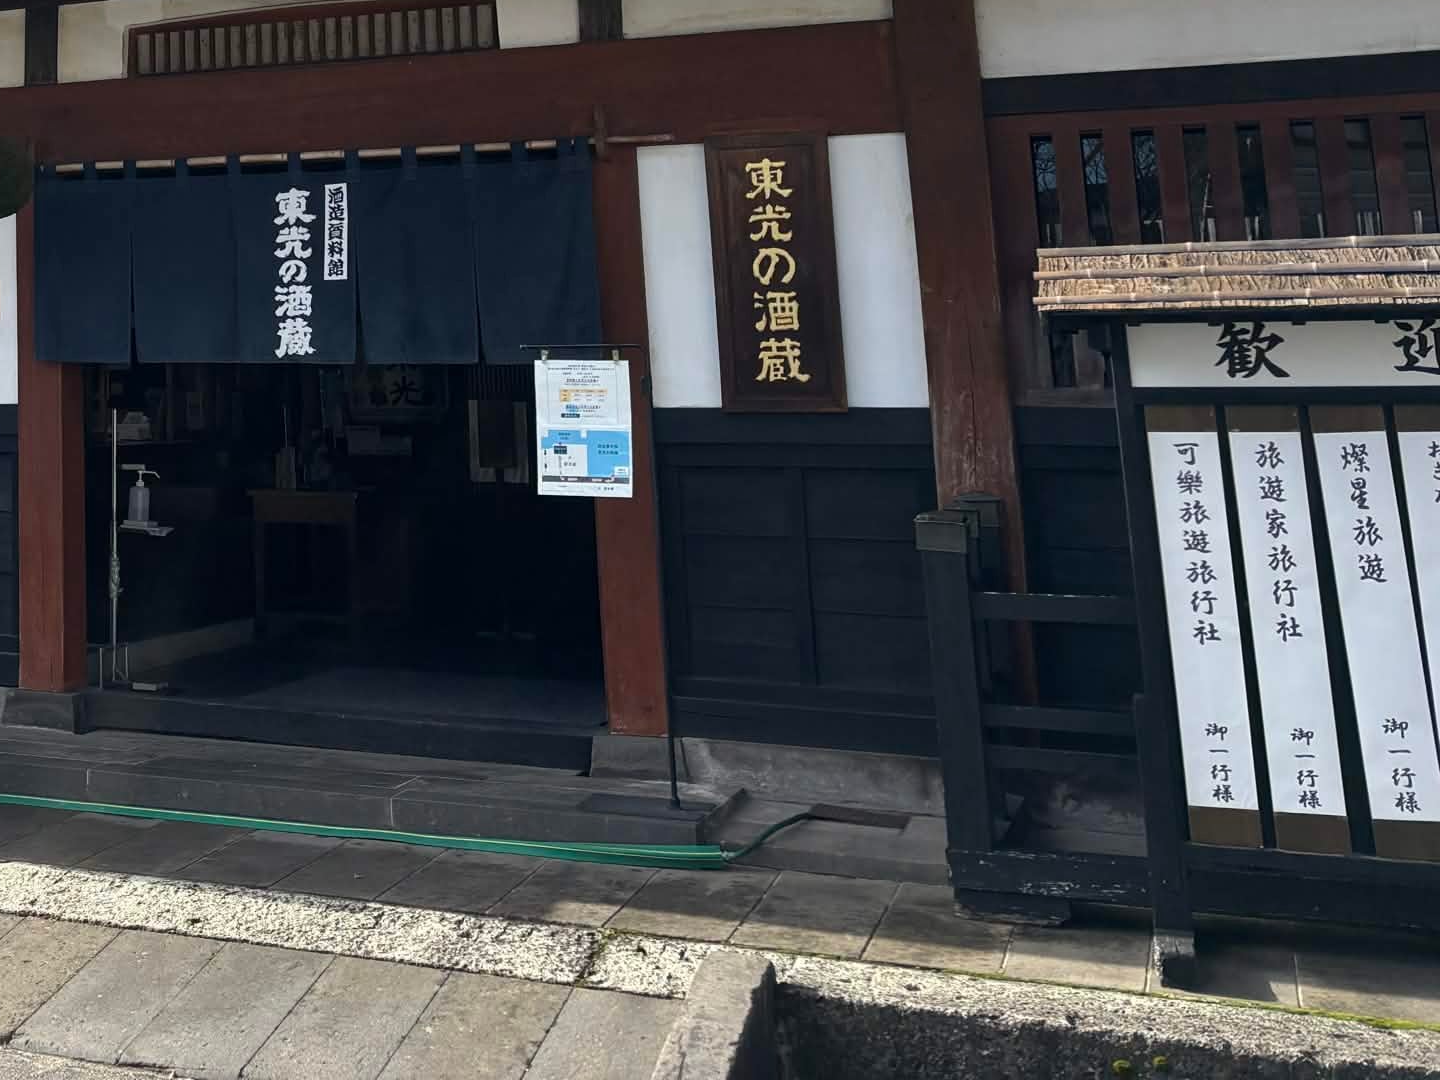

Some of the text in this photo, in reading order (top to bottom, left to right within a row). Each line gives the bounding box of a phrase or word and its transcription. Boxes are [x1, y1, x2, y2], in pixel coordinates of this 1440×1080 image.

[273, 187, 317, 359] 東光の酒蔵
[327, 186, 345, 278] 酒造資料館
[744, 157, 811, 383] 東光の酒蔵
[1173, 441, 1236, 803] 可樂旅遊旅行社 御一行様
[1255, 441, 1323, 810] 旅遊家旅行社 御一行様
[1340, 442, 1423, 814] 燦星旅遊 御一行様
